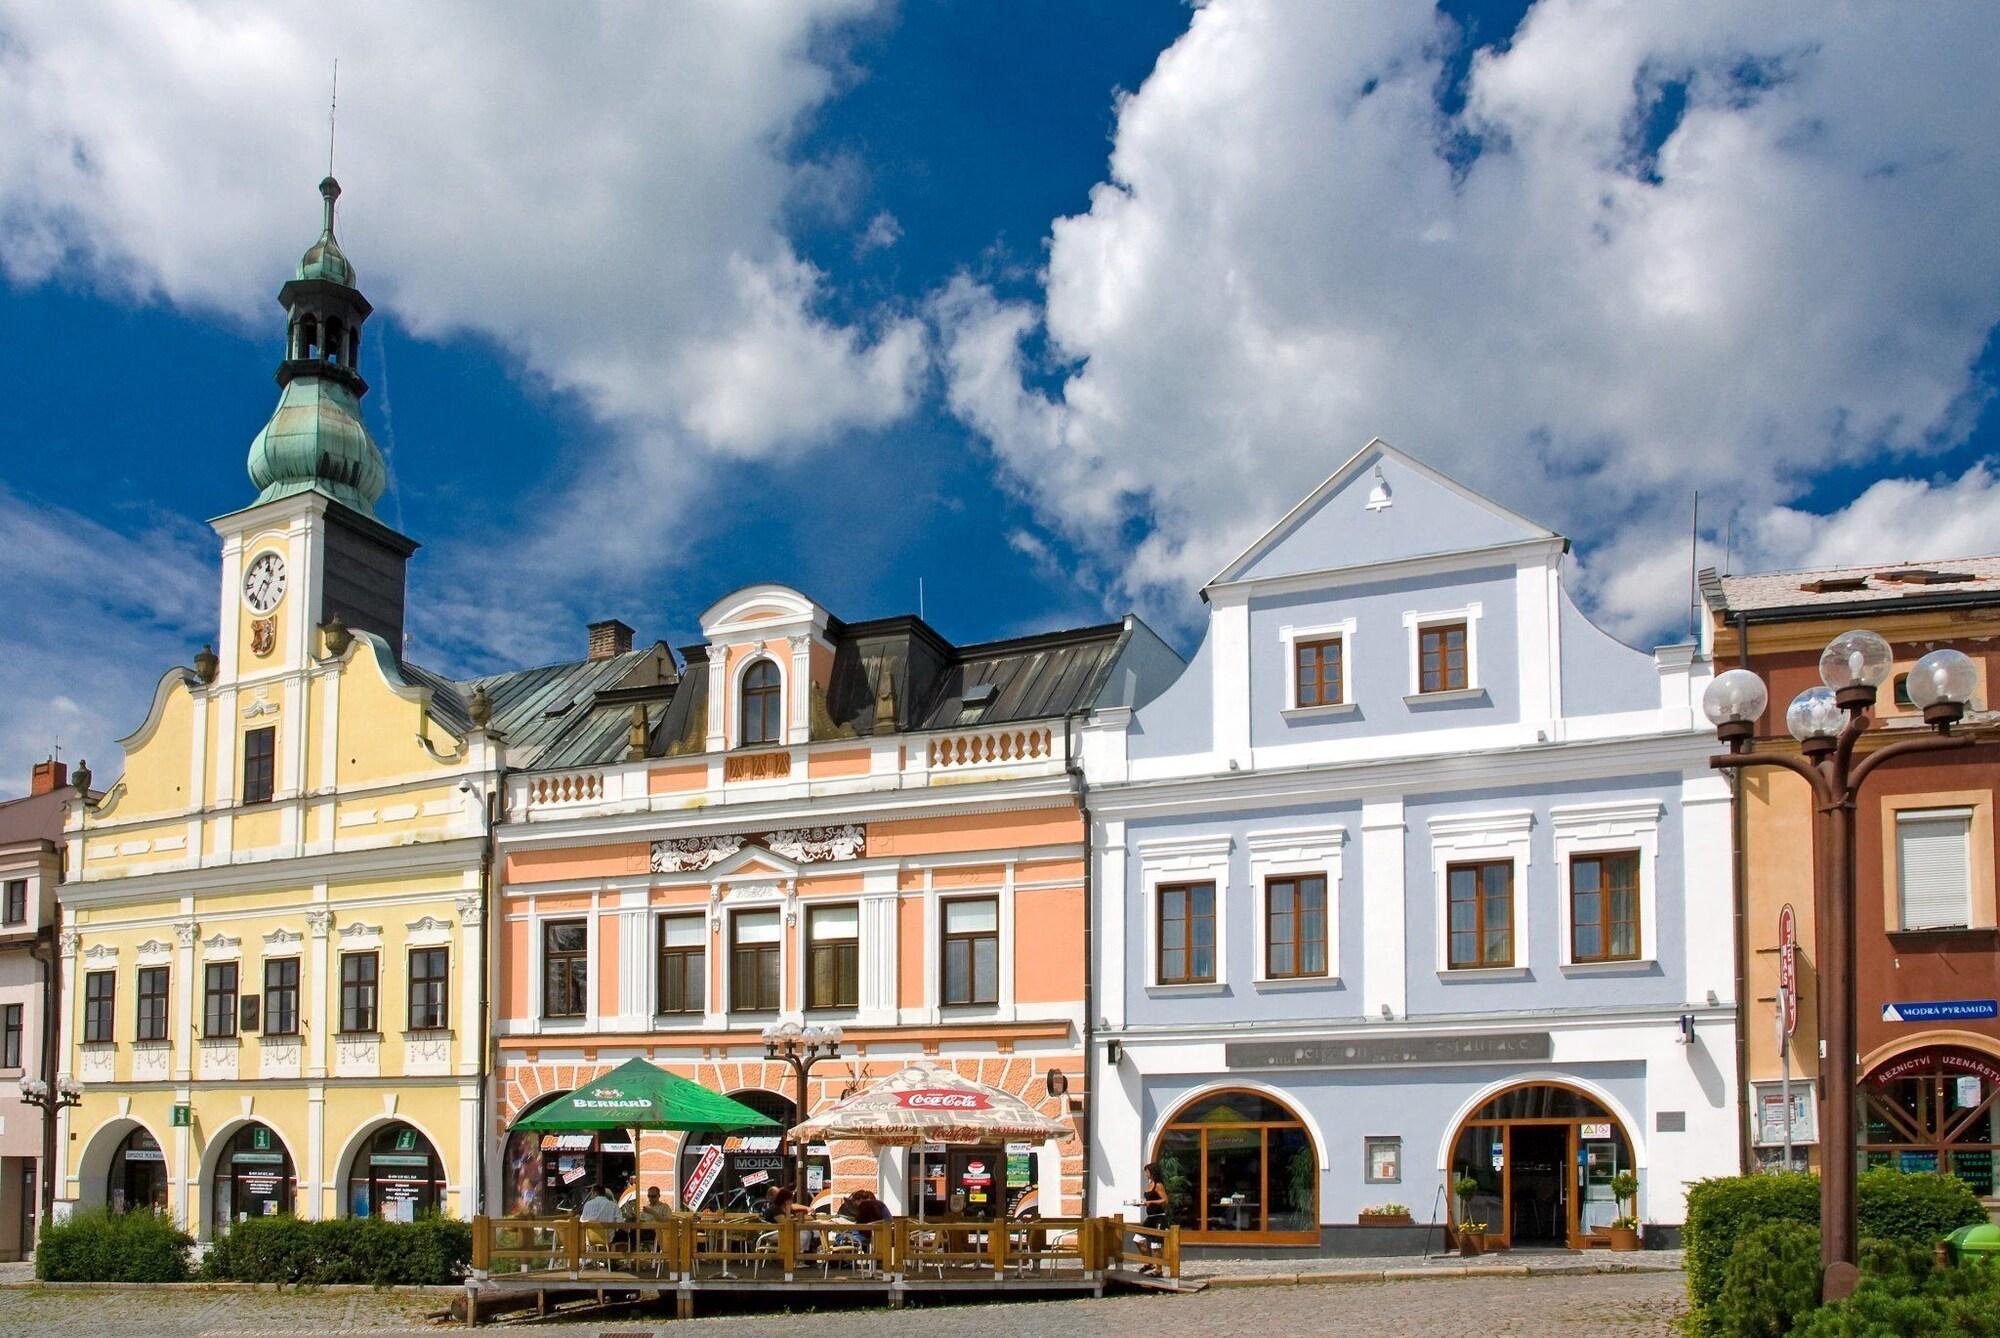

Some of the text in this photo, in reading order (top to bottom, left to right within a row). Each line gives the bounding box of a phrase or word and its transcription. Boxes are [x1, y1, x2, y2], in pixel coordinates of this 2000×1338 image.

[1942, 1005, 1993, 1014] PYRAMIDA
[1942, 1056, 2000, 1084] UZENÁŘSTV
[573, 1098, 653, 1108] BERNARD
[908, 1094, 977, 1108] Coca-Cola
[736, 1159, 781, 1168] MOIRA
